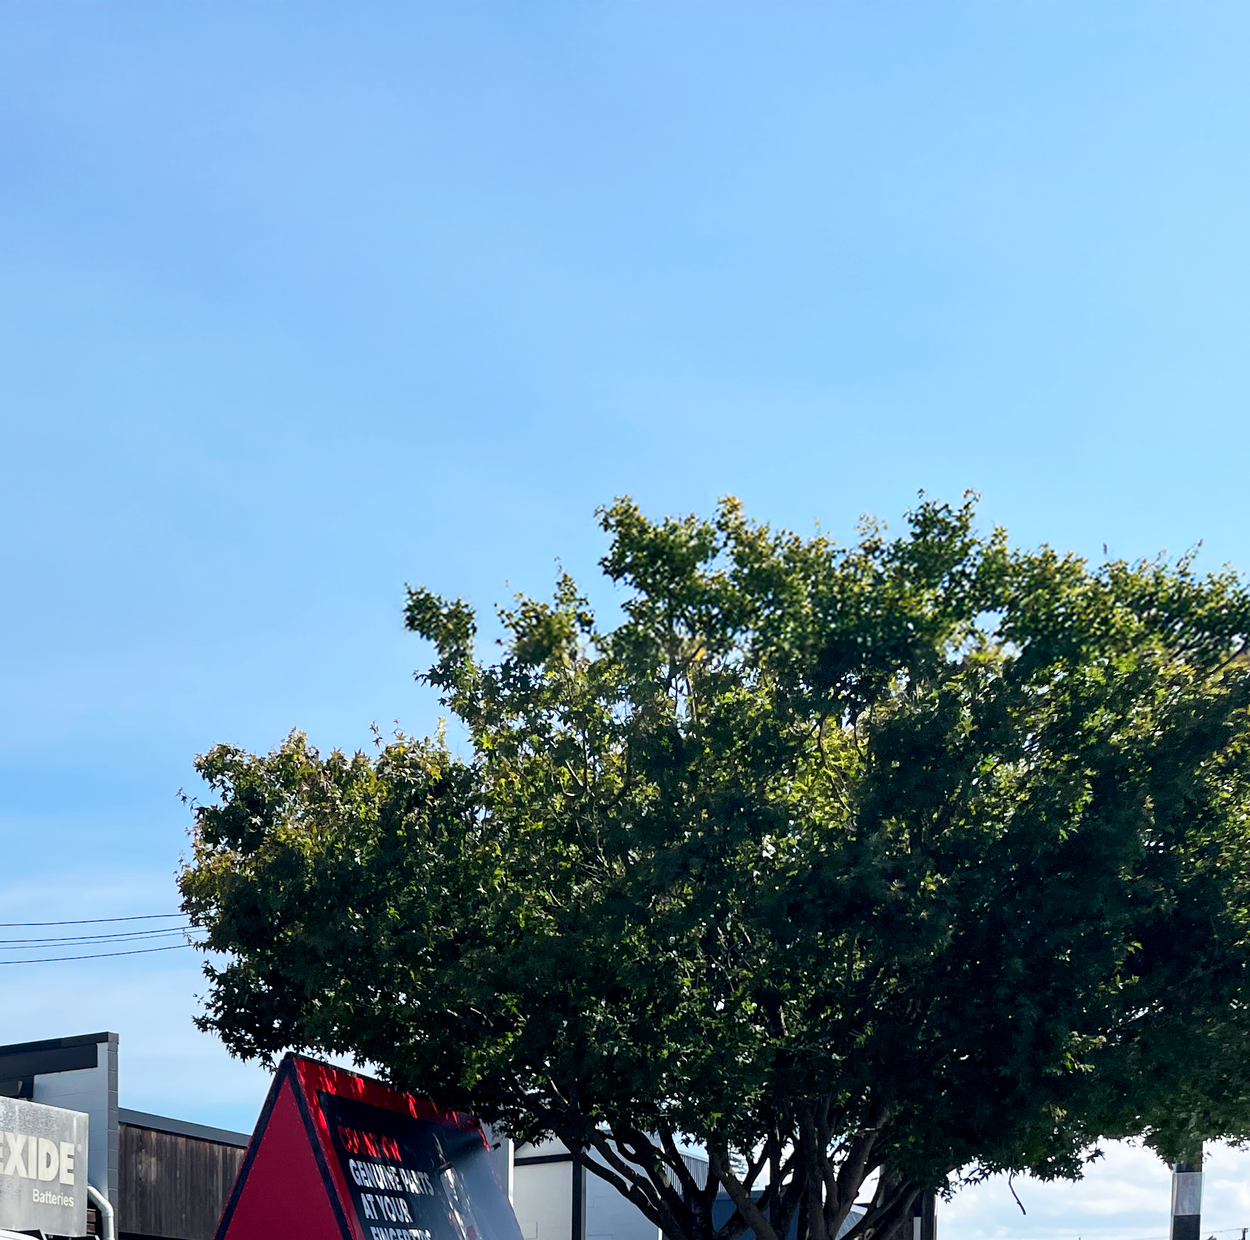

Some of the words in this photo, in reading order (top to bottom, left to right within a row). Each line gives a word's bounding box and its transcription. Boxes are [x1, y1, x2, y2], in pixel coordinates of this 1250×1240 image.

[349, 1158, 404, 1191] GENUINE
[398, 1168, 434, 1196] PARTS
[32, 1188, 75, 1207] Batteries
[360, 1192, 379, 1220] AT
[375, 1194, 413, 1223] YOUR
